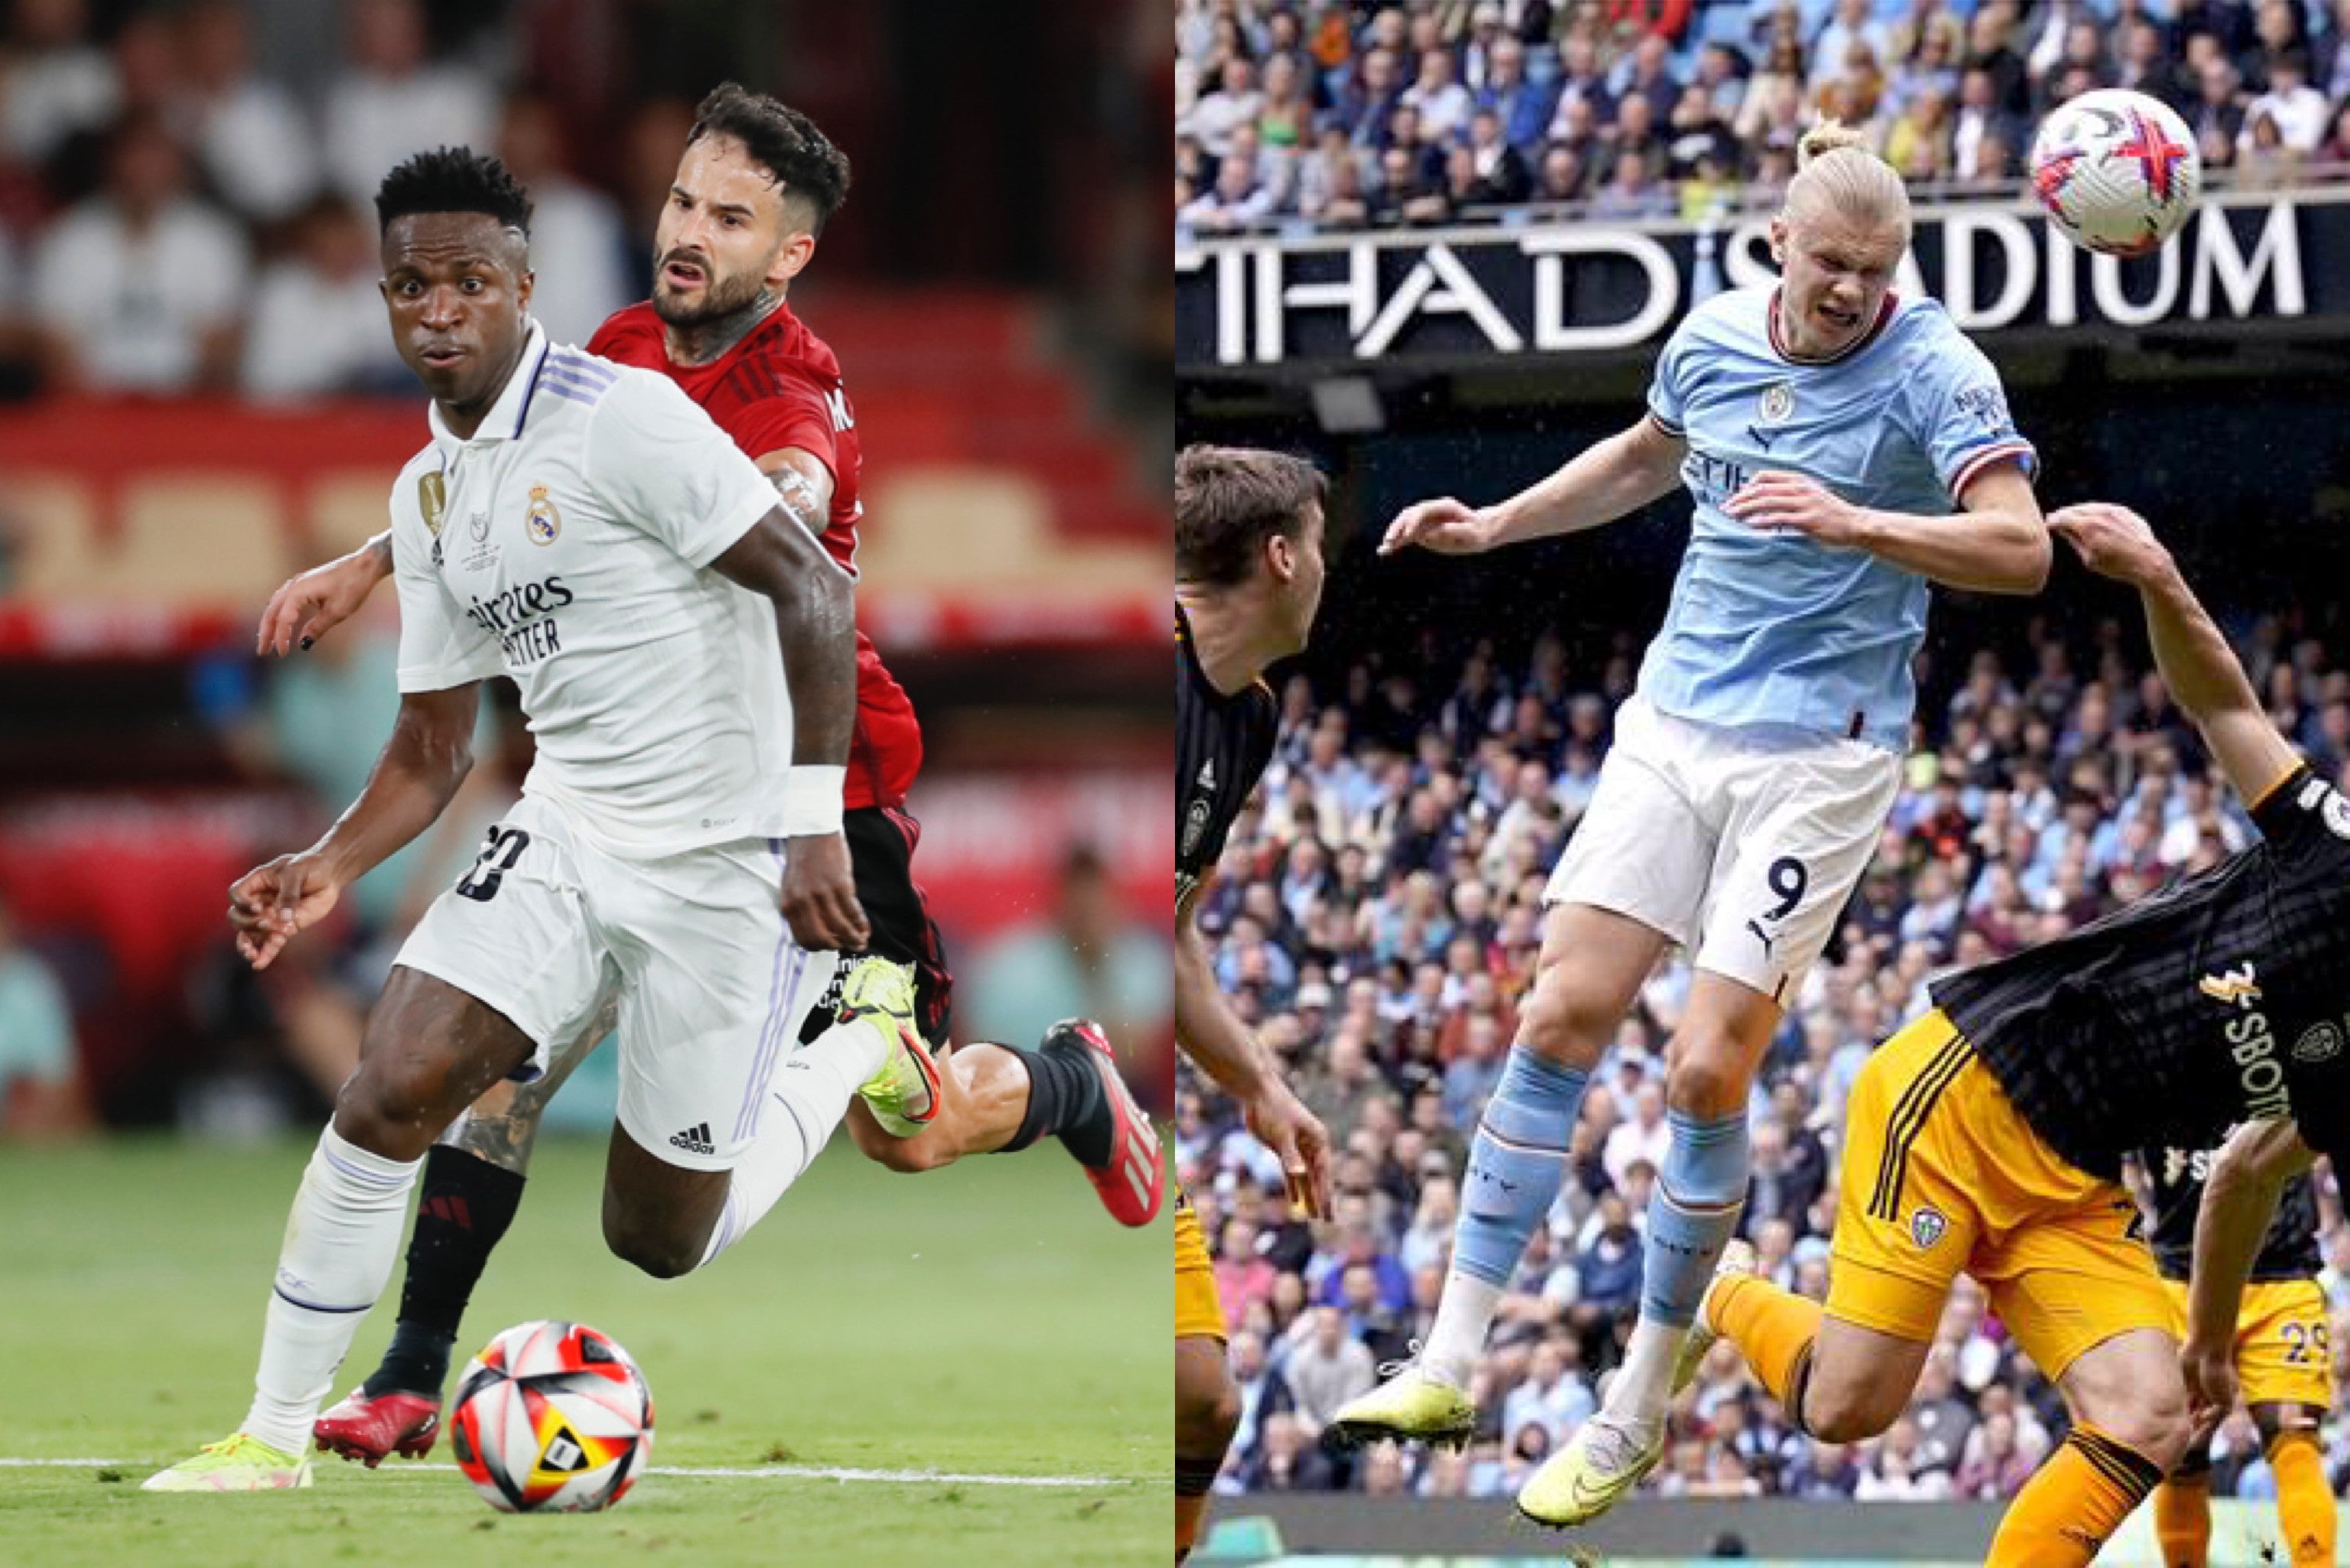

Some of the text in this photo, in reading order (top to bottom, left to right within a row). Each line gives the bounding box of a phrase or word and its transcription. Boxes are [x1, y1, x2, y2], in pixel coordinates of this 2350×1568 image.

[1177, 231, 1680, 364] IHAD
[1768, 856, 1808, 921] 9
[2225, 1012, 2292, 1121] SBOT
